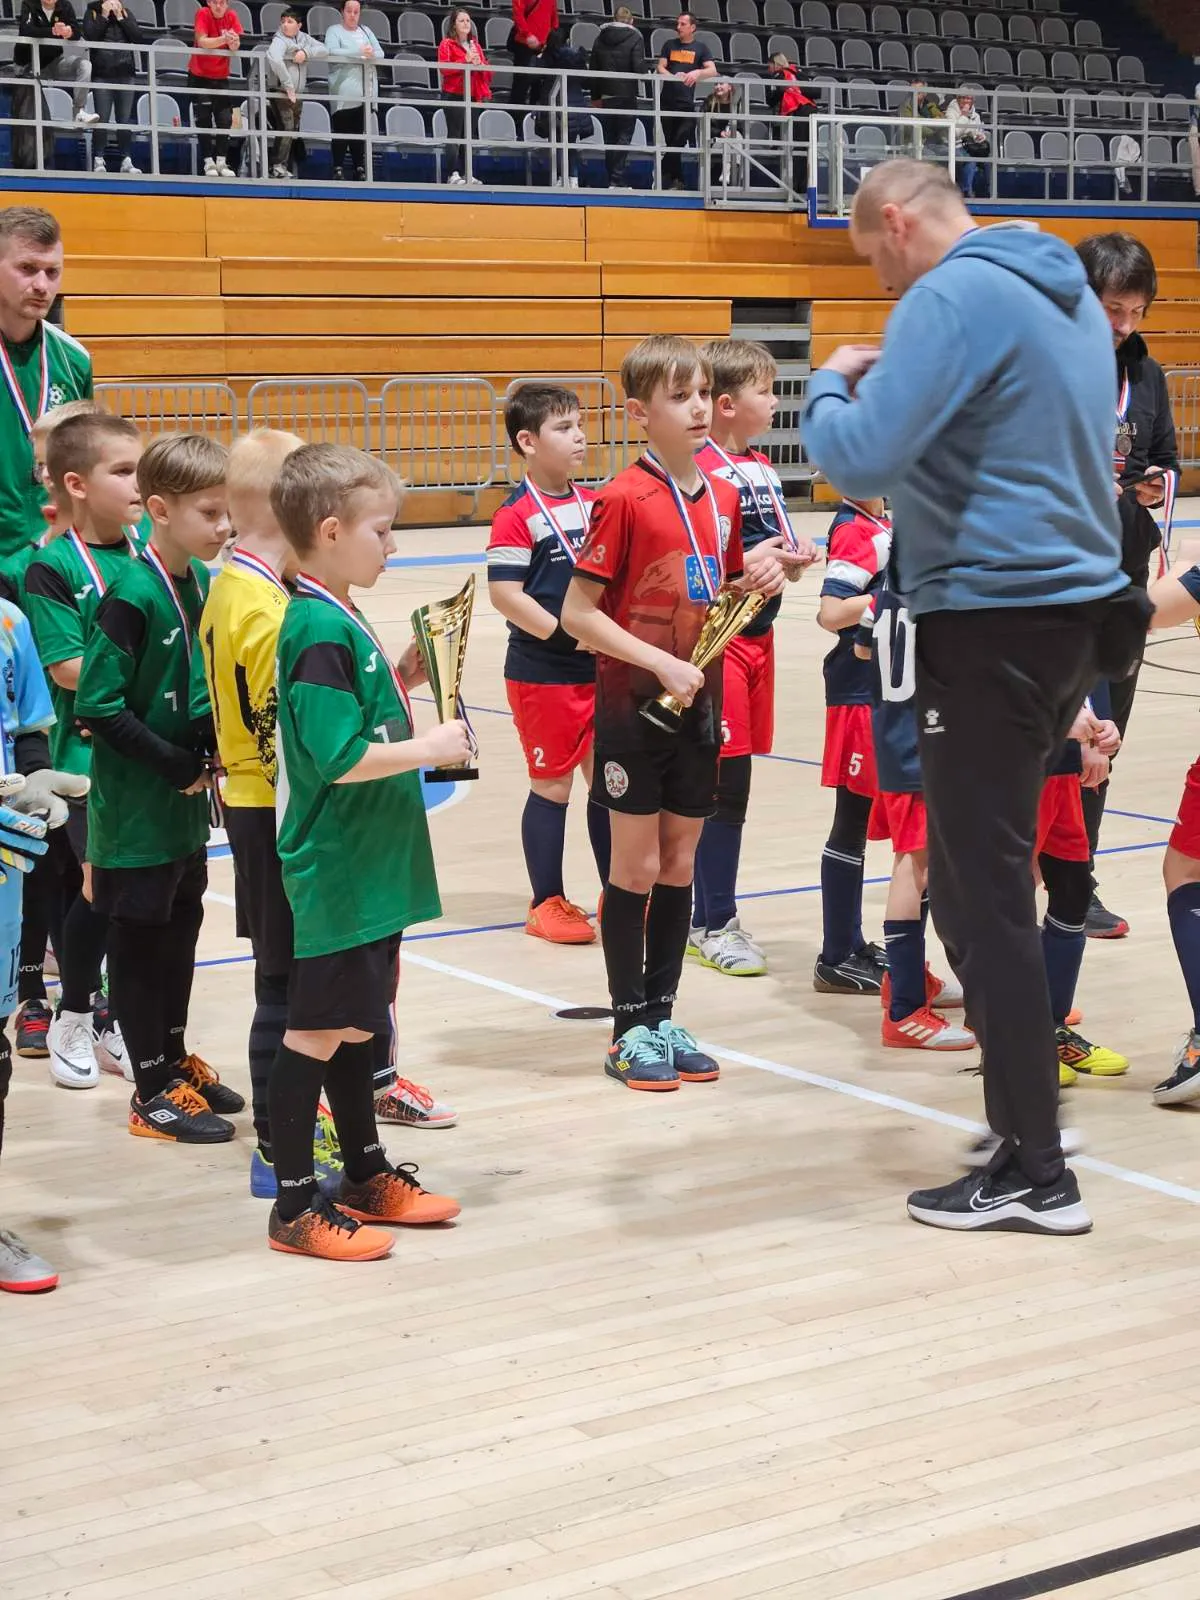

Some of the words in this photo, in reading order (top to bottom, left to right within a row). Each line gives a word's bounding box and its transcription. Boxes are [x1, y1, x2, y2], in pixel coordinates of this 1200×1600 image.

[872, 607, 918, 703] 10
[533, 746, 546, 768] 2
[848, 751, 864, 777] 5
